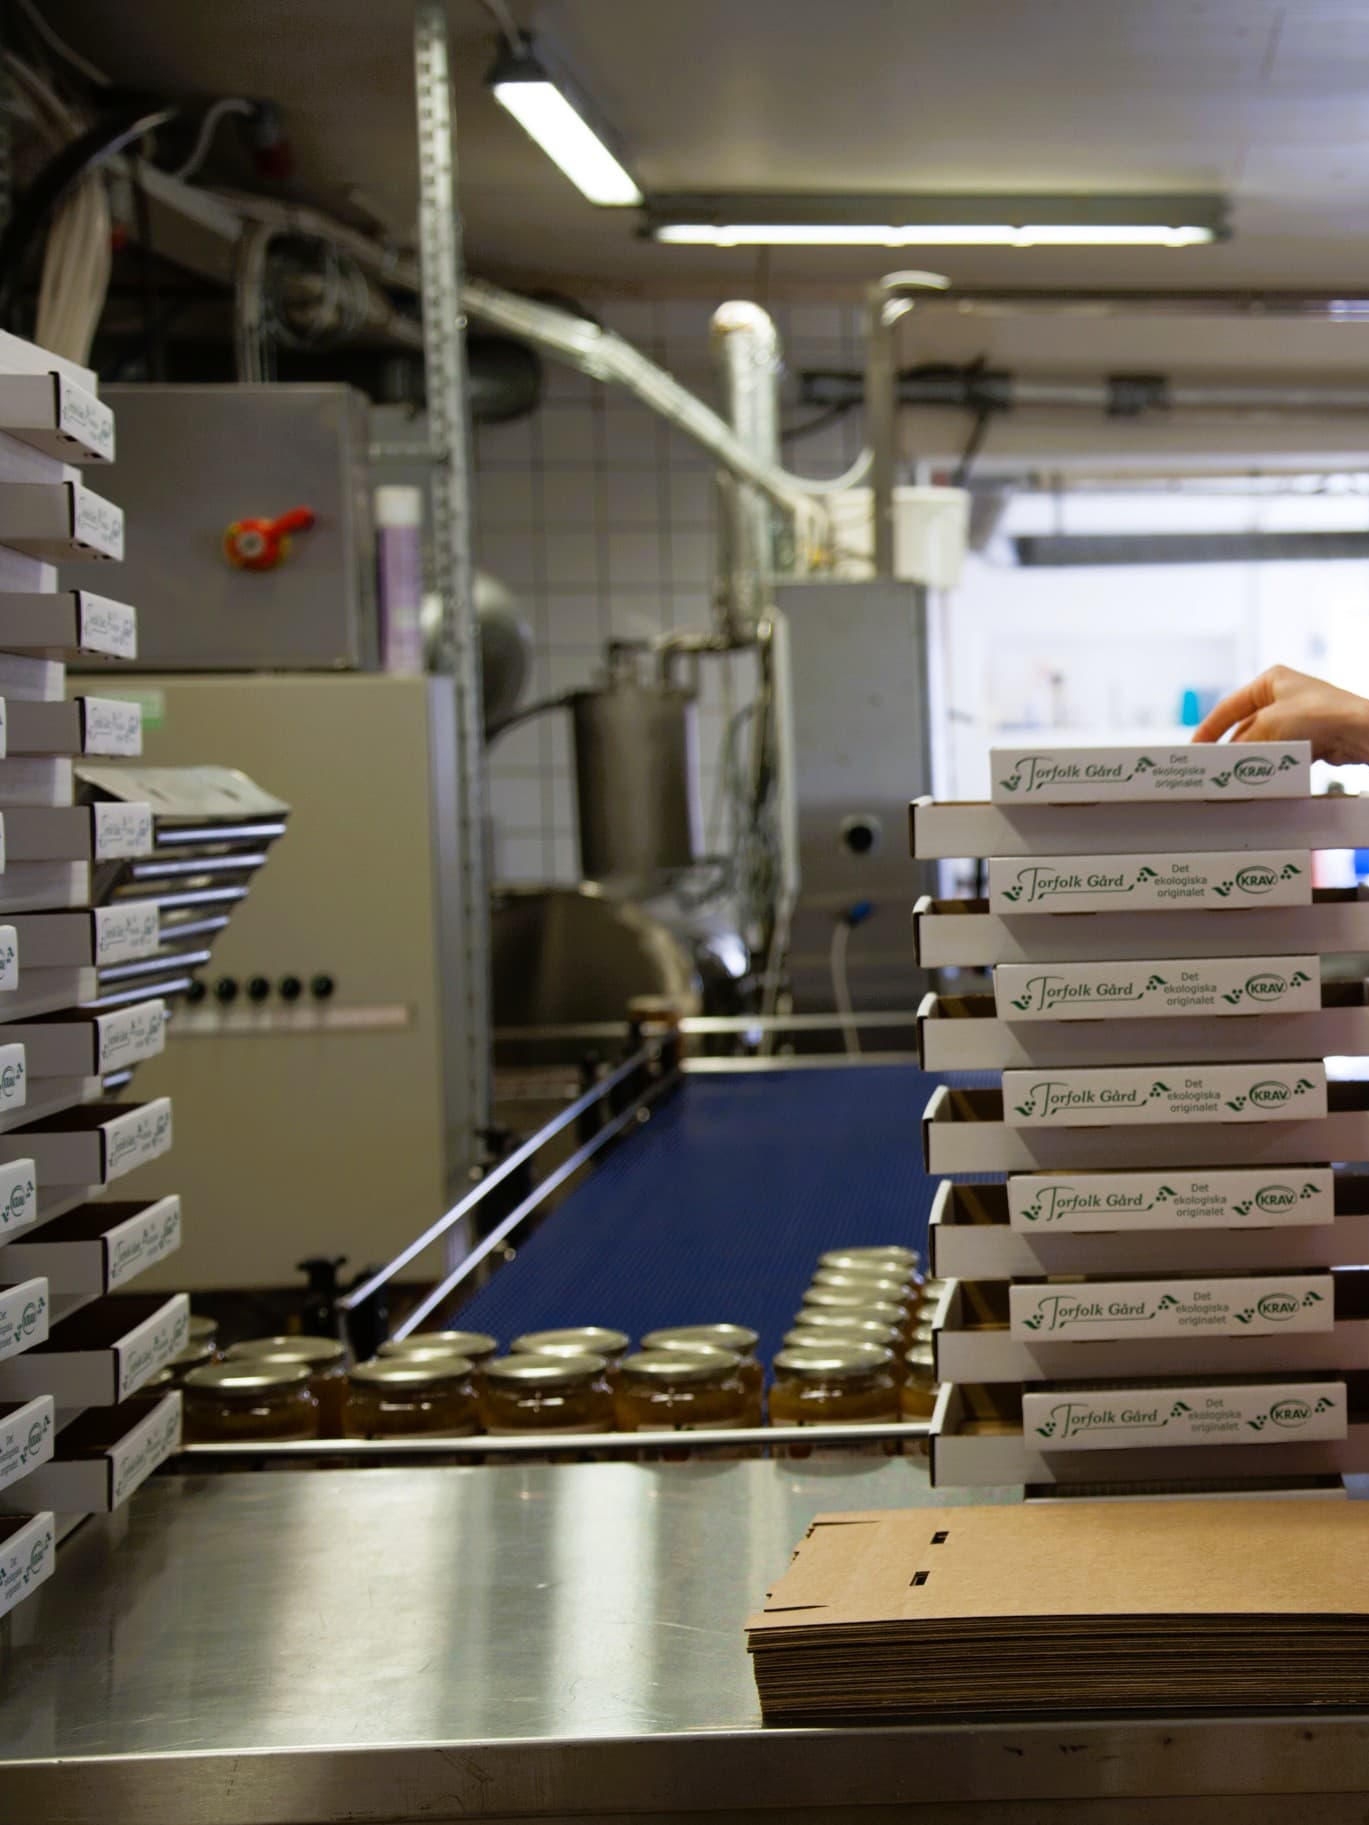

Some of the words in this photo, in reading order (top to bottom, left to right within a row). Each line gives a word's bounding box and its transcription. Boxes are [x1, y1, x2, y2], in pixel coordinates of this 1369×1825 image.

[1169, 754, 1187, 763] Det
[1015, 758, 1079, 792] Torfolk
[1085, 765, 1121, 778] Gård
[1152, 766, 1205, 776] ekologiska
[1238, 765, 1272, 776] KRAV
[1155, 778, 1202, 788] originalet
[1171, 864, 1189, 873] Det
[1017, 867, 1081, 901] Torfolk
[1087, 874, 1123, 887] Gård
[1154, 876, 1207, 886] ekologiska
[1240, 875, 1274, 886] KRAV
[1157, 888, 1205, 898] originalet
[1181, 972, 1198, 980] Det
[1026, 975, 1091, 1009] Torfolk
[1096, 982, 1133, 995] Gård
[1164, 984, 1217, 994] ekologiska
[1250, 982, 1284, 994] KRAV
[1166, 995, 1214, 1006] originalet
[1184, 1079, 1202, 1088] Det
[1030, 1082, 1095, 1116] Torfolk
[1100, 1089, 1137, 1102] Gård
[1167, 1091, 1220, 1101] ekologiska
[1253, 1090, 1287, 1101] KRAV
[1170, 1103, 1218, 1113] originalet
[1190, 1183, 1208, 1192] Det
[1036, 1187, 1101, 1221] Torfolk
[1106, 1194, 1143, 1207] Gård
[1173, 1195, 1226, 1205] ekologiska
[1260, 1194, 1294, 1205] KRAV
[1176, 1207, 1224, 1217] originalet
[1193, 1291, 1210, 1300] Det
[1038, 1295, 1103, 1329] Torfolk
[1108, 1302, 1145, 1315] Gård
[1176, 1303, 1229, 1313] ekologiska
[1262, 1302, 1296, 1313] KRAV
[1178, 1315, 1226, 1325] originalet
[1205, 1399, 1223, 1408] Det
[1051, 1402, 1115, 1436] Torfolk
[1121, 1409, 1157, 1422] Gård
[1188, 1411, 1241, 1421] ekologiska
[1274, 1410, 1308, 1421] KRAV
[1191, 1423, 1238, 1433] originalet
